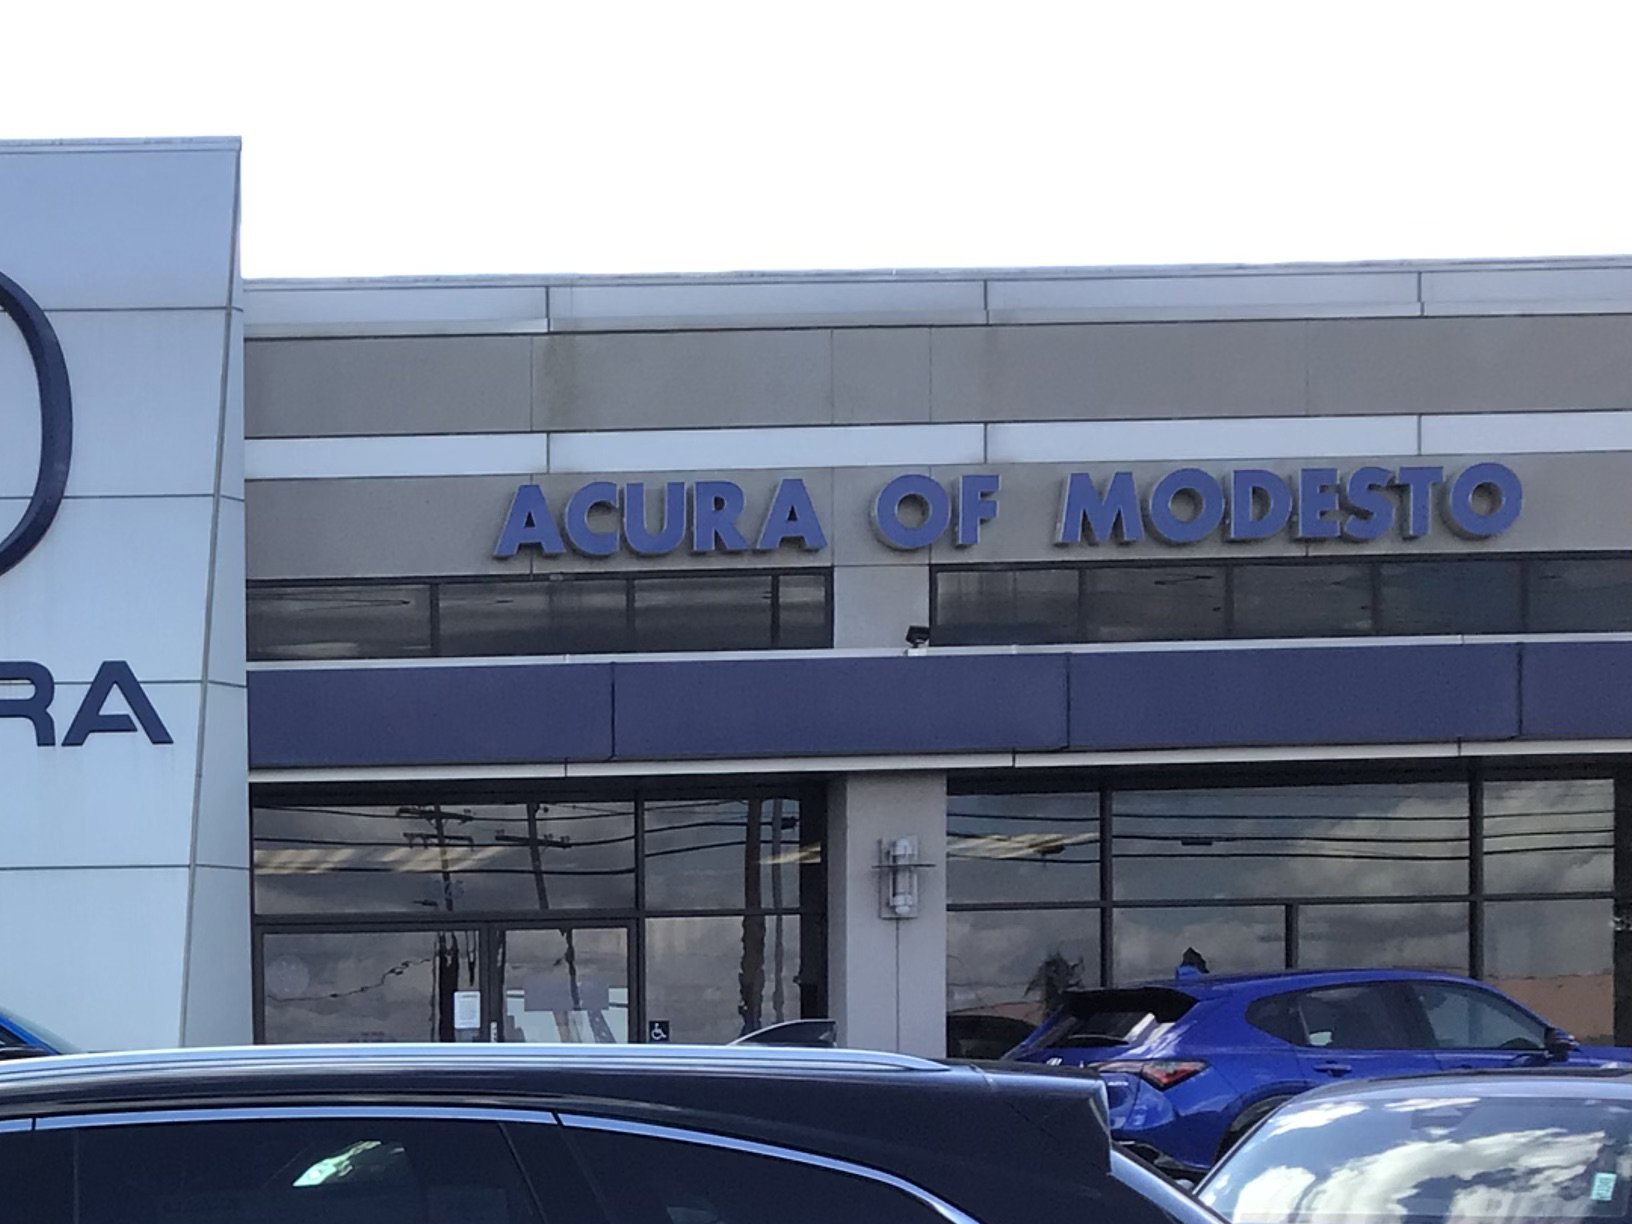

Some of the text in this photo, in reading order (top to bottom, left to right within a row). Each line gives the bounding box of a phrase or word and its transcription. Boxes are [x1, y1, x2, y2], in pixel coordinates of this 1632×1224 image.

[492, 461, 1523, 559] ACURA OF MODESTO
